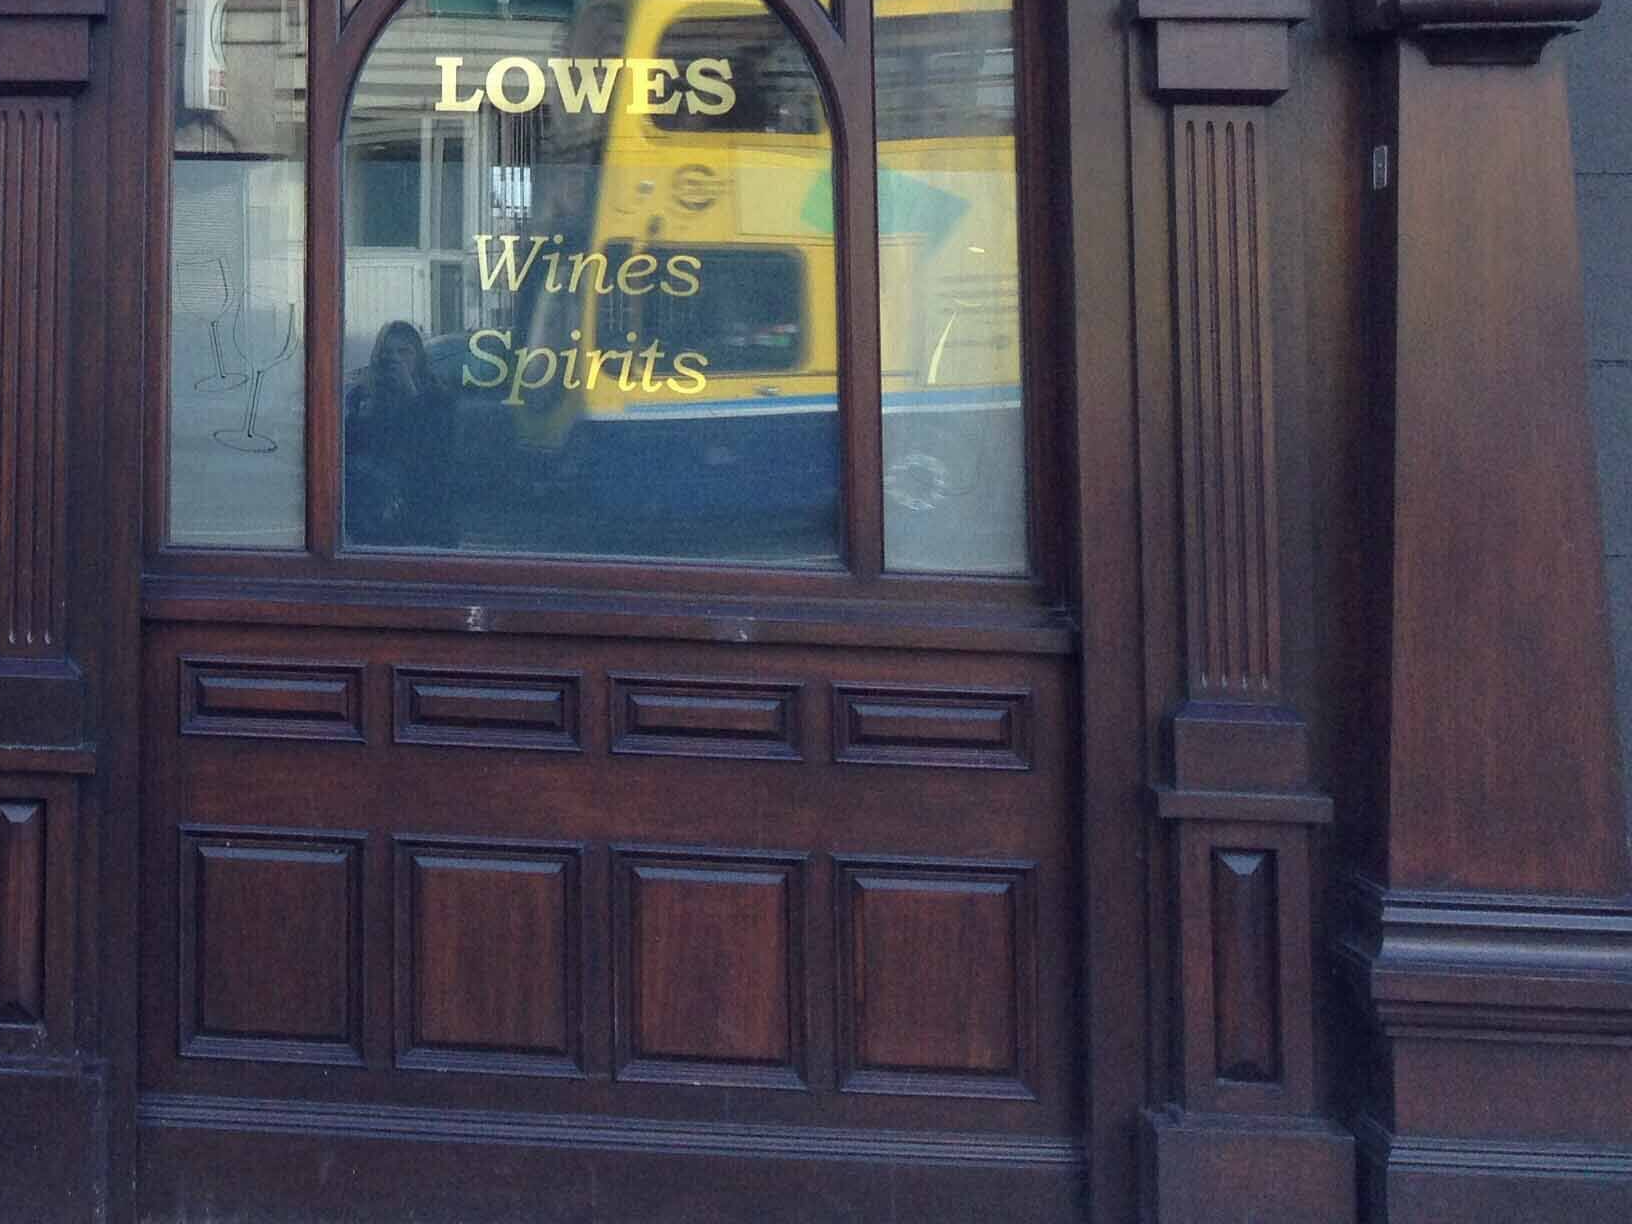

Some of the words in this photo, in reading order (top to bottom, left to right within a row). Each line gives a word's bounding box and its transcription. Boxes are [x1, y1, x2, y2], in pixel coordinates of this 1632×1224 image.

[433, 56, 736, 117] LOWES
[472, 233, 703, 299] Wines
[460, 328, 710, 407] Spirits
